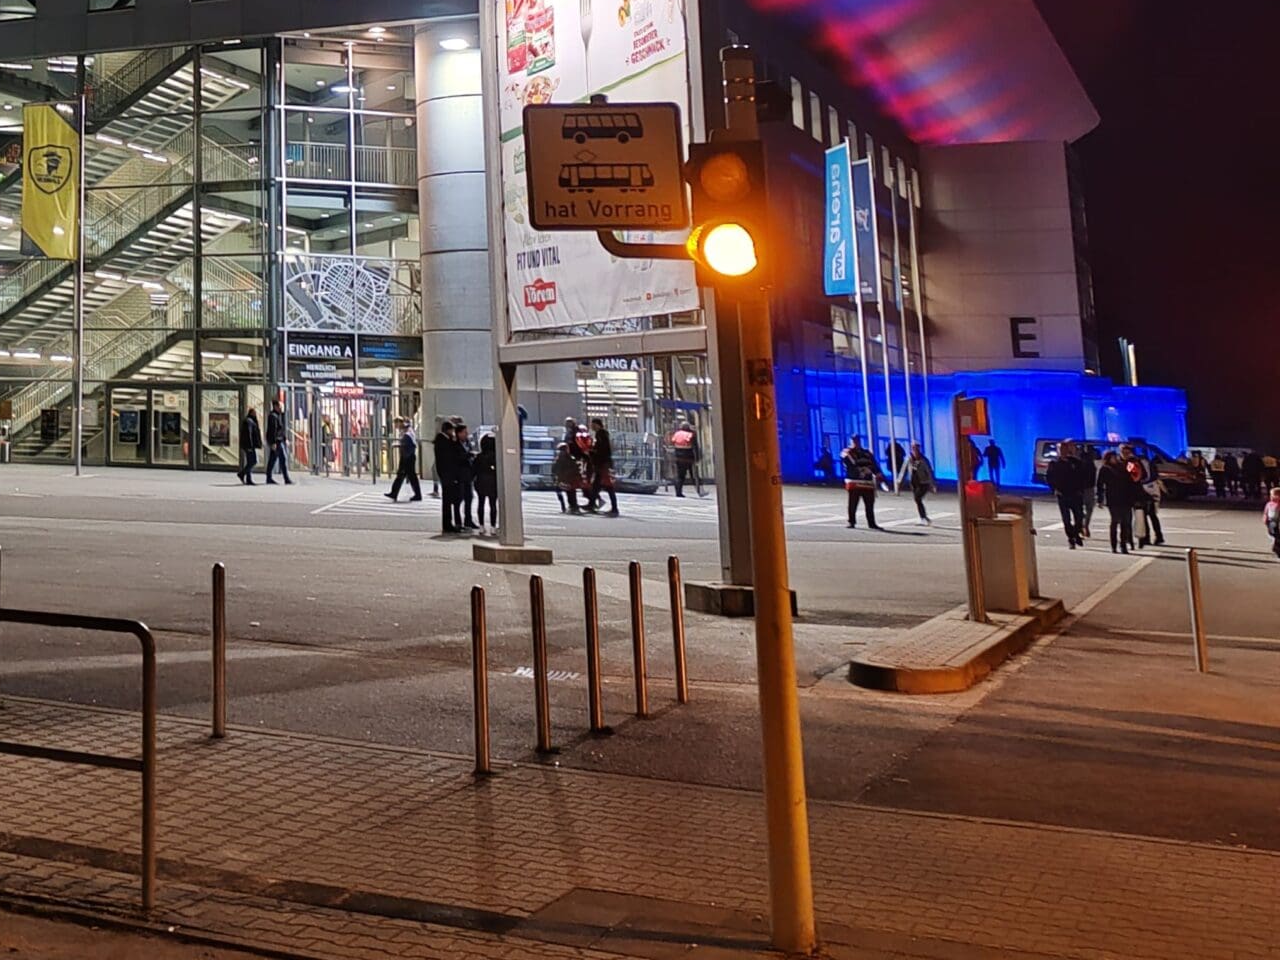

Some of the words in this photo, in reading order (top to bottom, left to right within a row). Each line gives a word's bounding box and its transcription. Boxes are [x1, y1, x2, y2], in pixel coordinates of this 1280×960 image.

[545, 201, 577, 218] hat
[588, 200, 672, 221] Vorrang
[541, 246, 560, 266] VITAL
[1009, 317, 1040, 359] E
[288, 343, 341, 357] EINGANG
[344, 347, 353, 357] A
